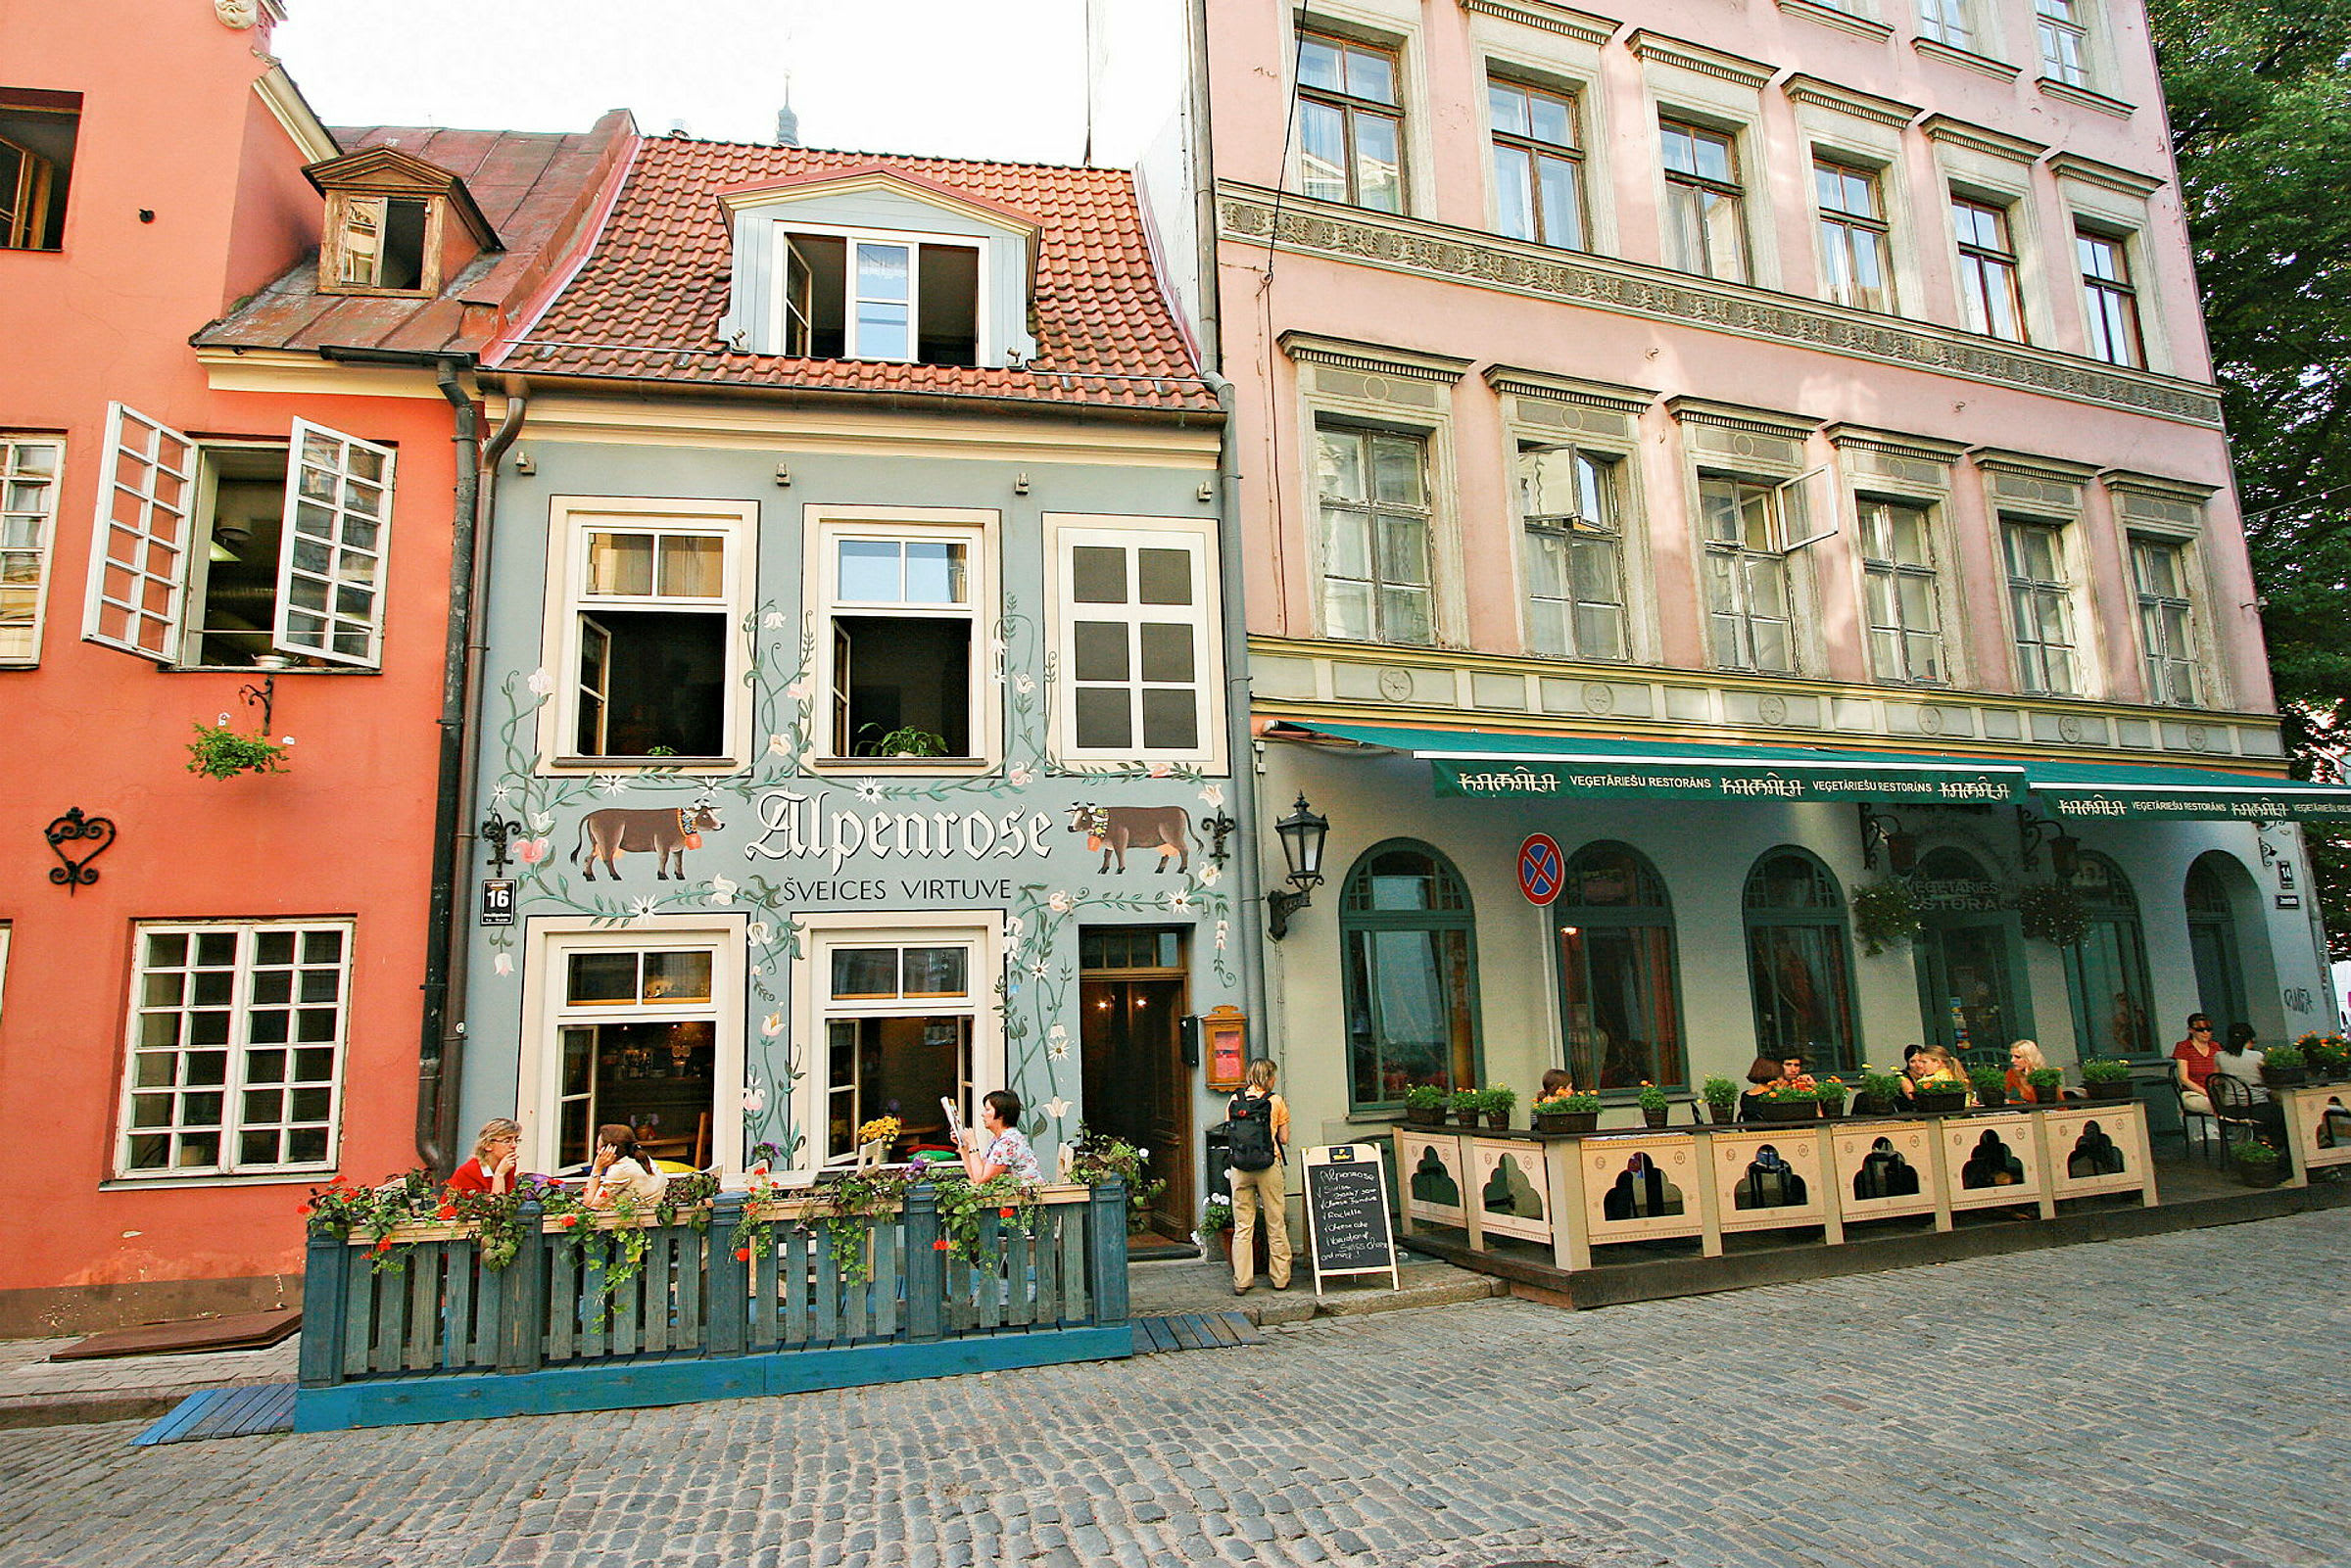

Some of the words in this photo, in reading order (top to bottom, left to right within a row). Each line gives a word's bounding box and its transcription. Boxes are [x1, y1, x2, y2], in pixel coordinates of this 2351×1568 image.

[1569, 774, 1646, 788] VEĢETĀRIEŠU
[1648, 775, 1711, 788] RESTORĀNS
[744, 785, 1054, 876] Alpenrose
[487, 889, 509, 908] 16
[784, 876, 887, 901] ŠVEICES
[901, 879, 1012, 900] VIRTUVE
